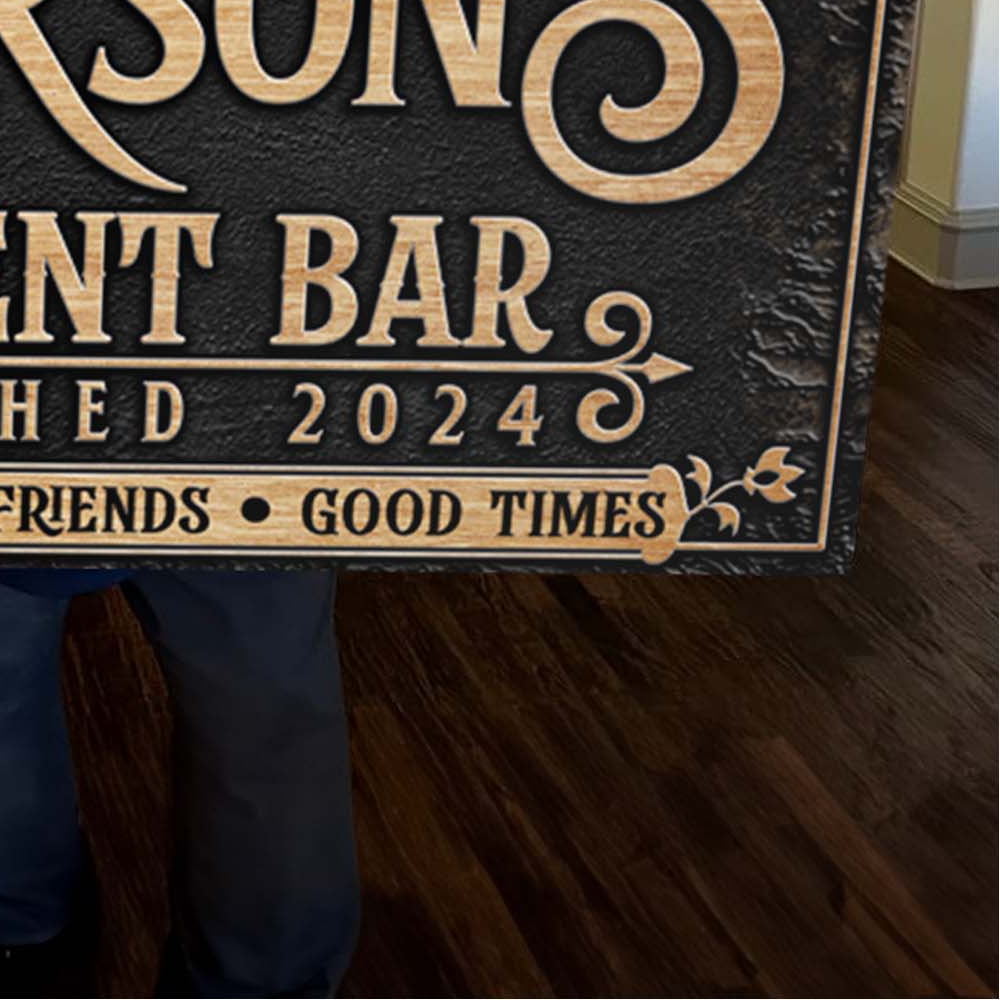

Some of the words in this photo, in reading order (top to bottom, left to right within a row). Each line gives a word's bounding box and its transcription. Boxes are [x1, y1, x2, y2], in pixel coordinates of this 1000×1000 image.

[270, 214, 554, 354] BAR
[287, 382, 543, 447] 2024
[301, 487, 463, 537] GOOD
[490, 490, 667, 539] TIMES
